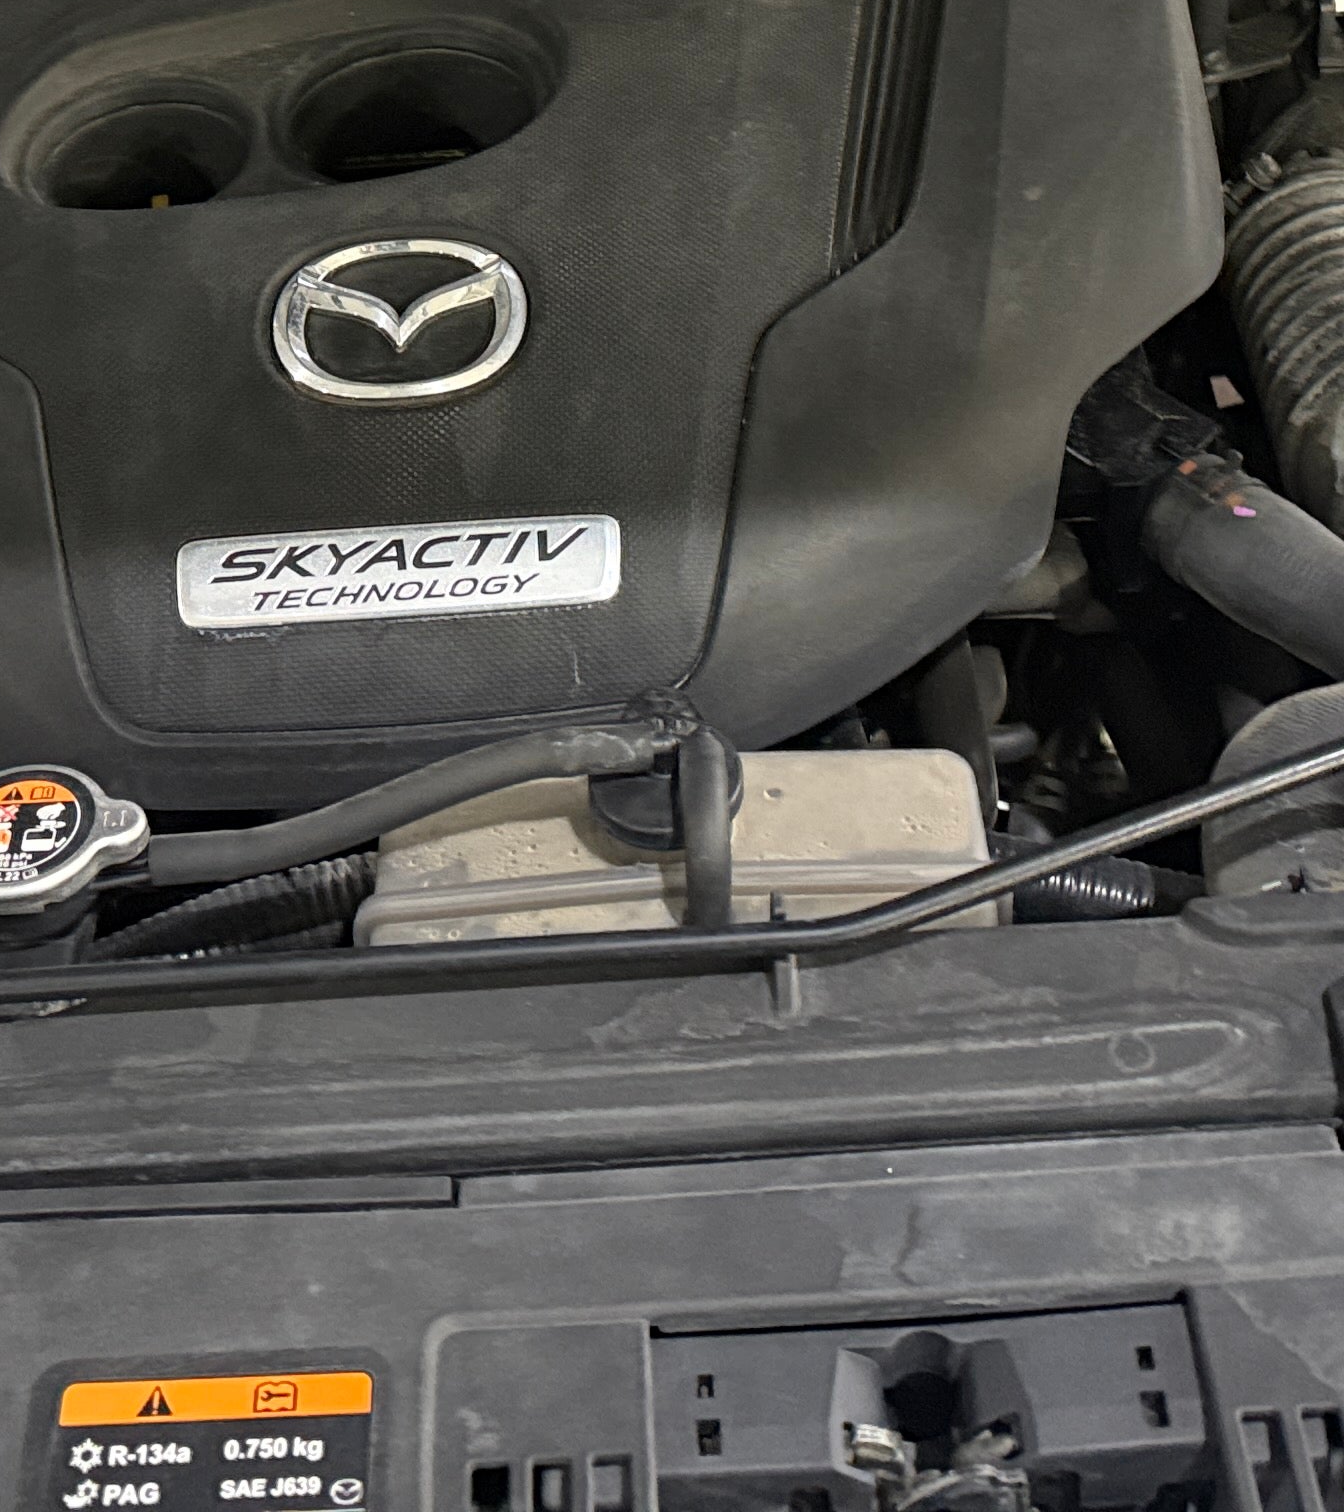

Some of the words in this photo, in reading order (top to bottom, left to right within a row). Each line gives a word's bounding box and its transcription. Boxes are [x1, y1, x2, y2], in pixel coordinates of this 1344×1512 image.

[211, 527, 588, 584] SKYACTIV
[253, 572, 540, 611] TECHNOLOGY
[107, 1443, 192, 1467] R-134a
[223, 1438, 288, 1461] 0.750
[293, 1436, 325, 1462] kg
[104, 1482, 162, 1506] PAG
[219, 1478, 267, 1499] SAE
[270, 1476, 322, 1497] J639
